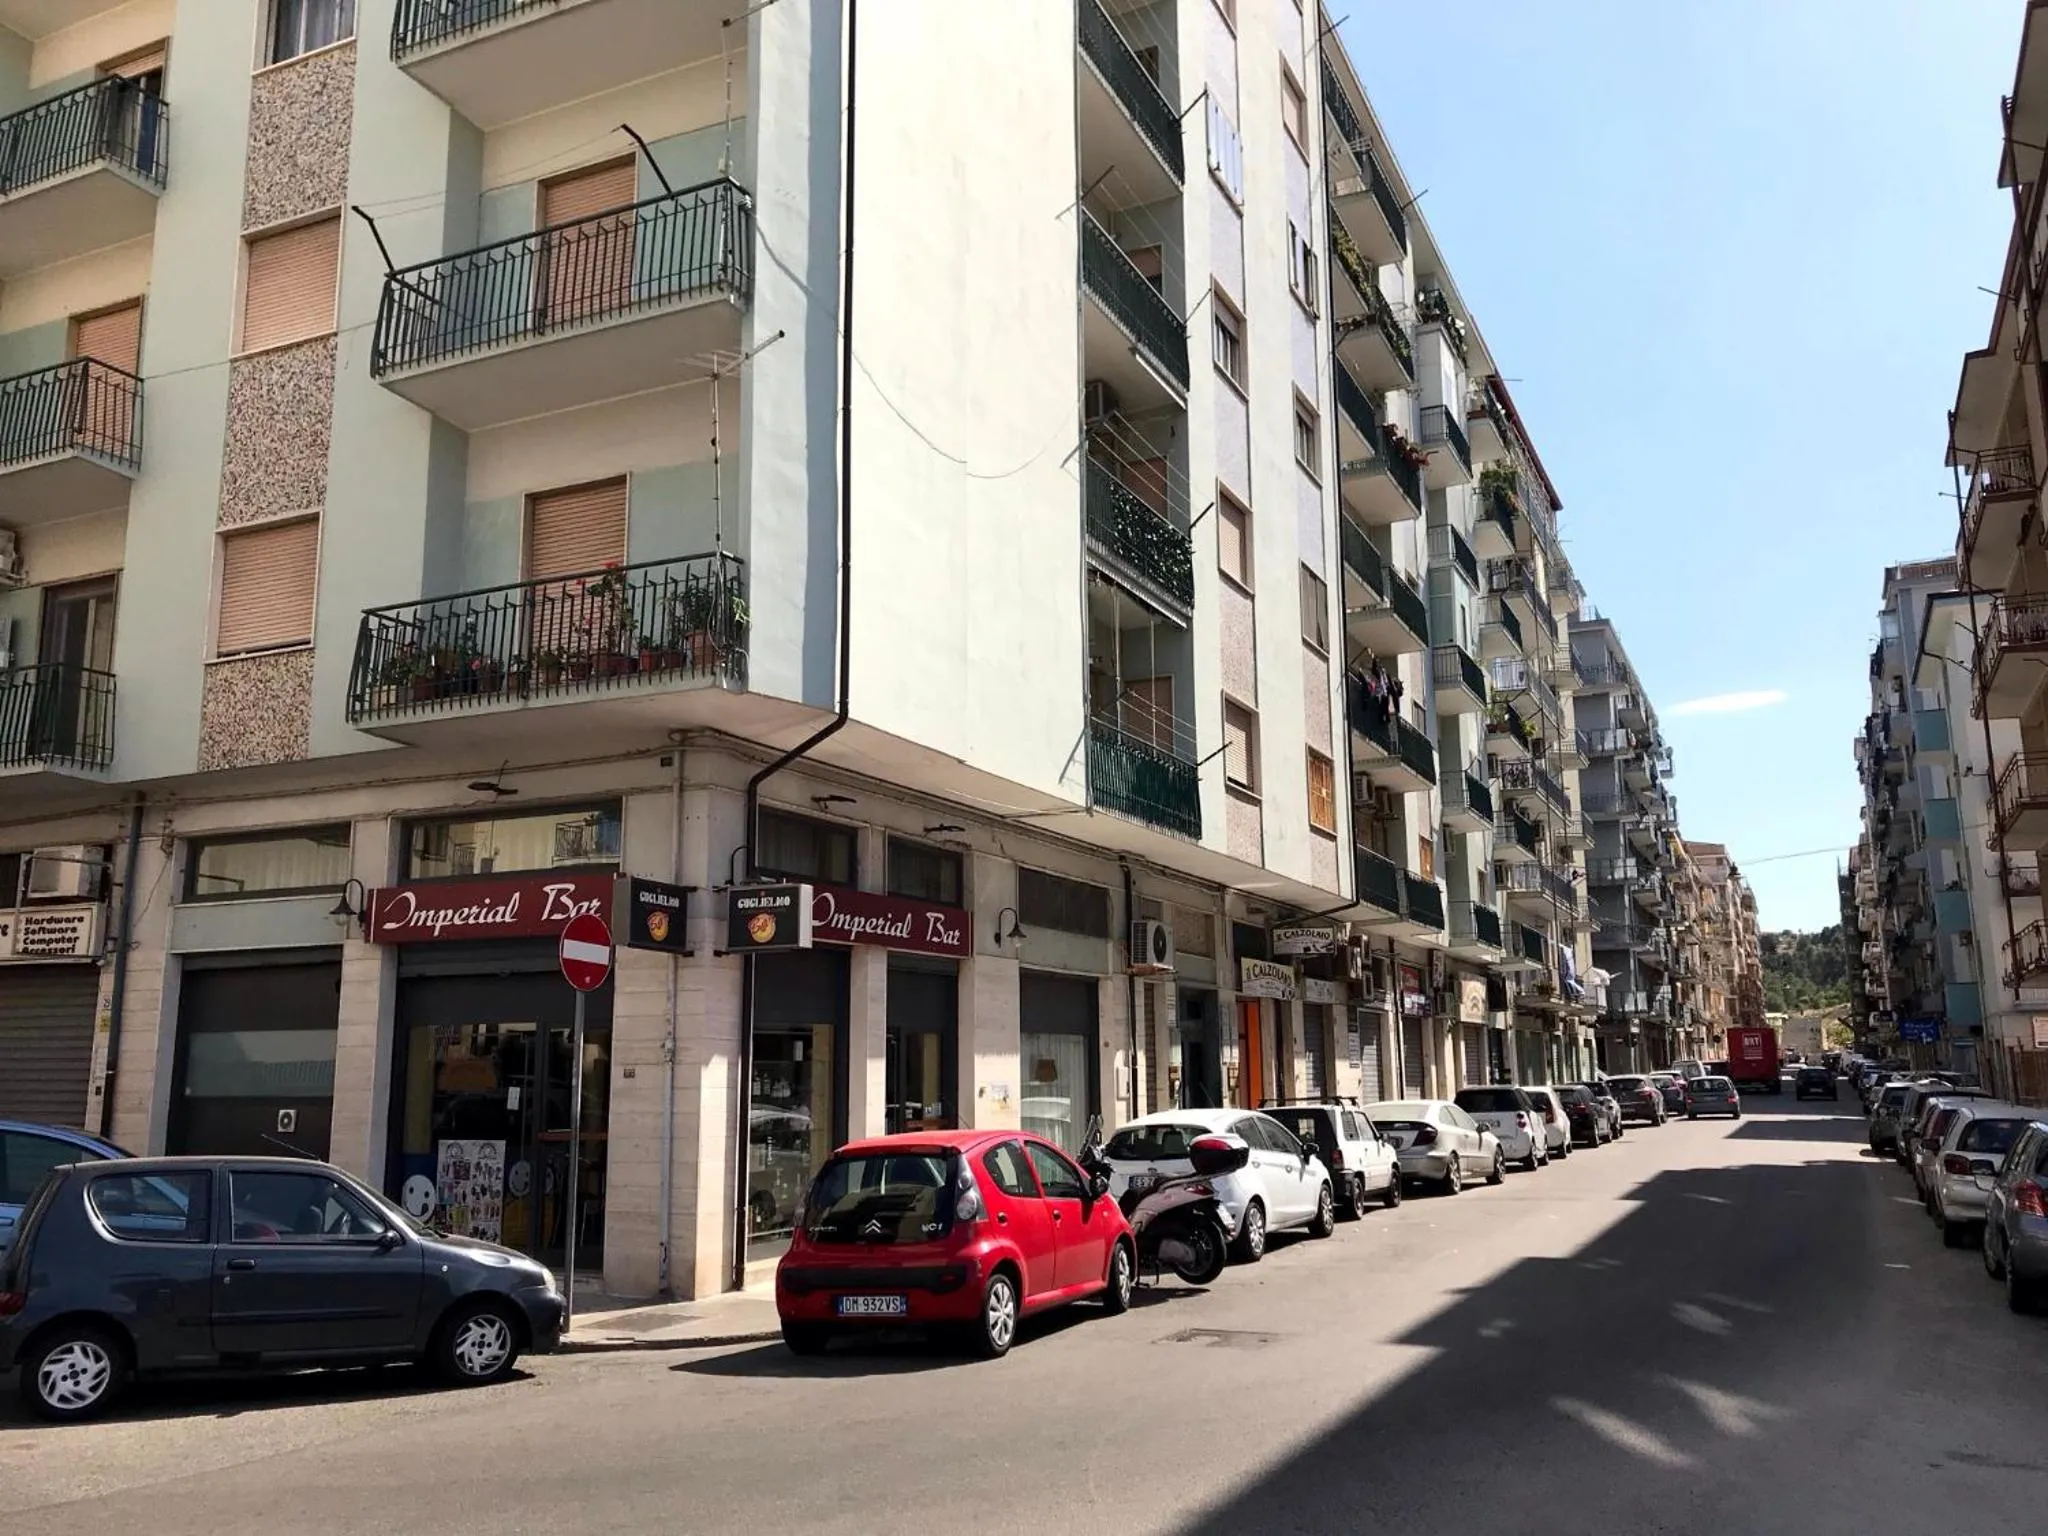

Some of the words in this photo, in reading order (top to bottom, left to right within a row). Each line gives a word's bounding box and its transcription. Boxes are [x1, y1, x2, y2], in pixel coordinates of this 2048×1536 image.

[639, 891, 680, 909] GUGLIELMO
[737, 896, 791, 909] GUGLIELMO
[383, 891, 521, 937] Imperial
[541, 883, 601, 921] Bar
[25, 915, 85, 926] Hardware
[812, 892, 912, 940] Imperial
[926, 911, 961, 946] Bar
[24, 926, 78, 936] Software
[23, 936, 80, 947] Computer
[862, 1297, 899, 1312] 932VS
